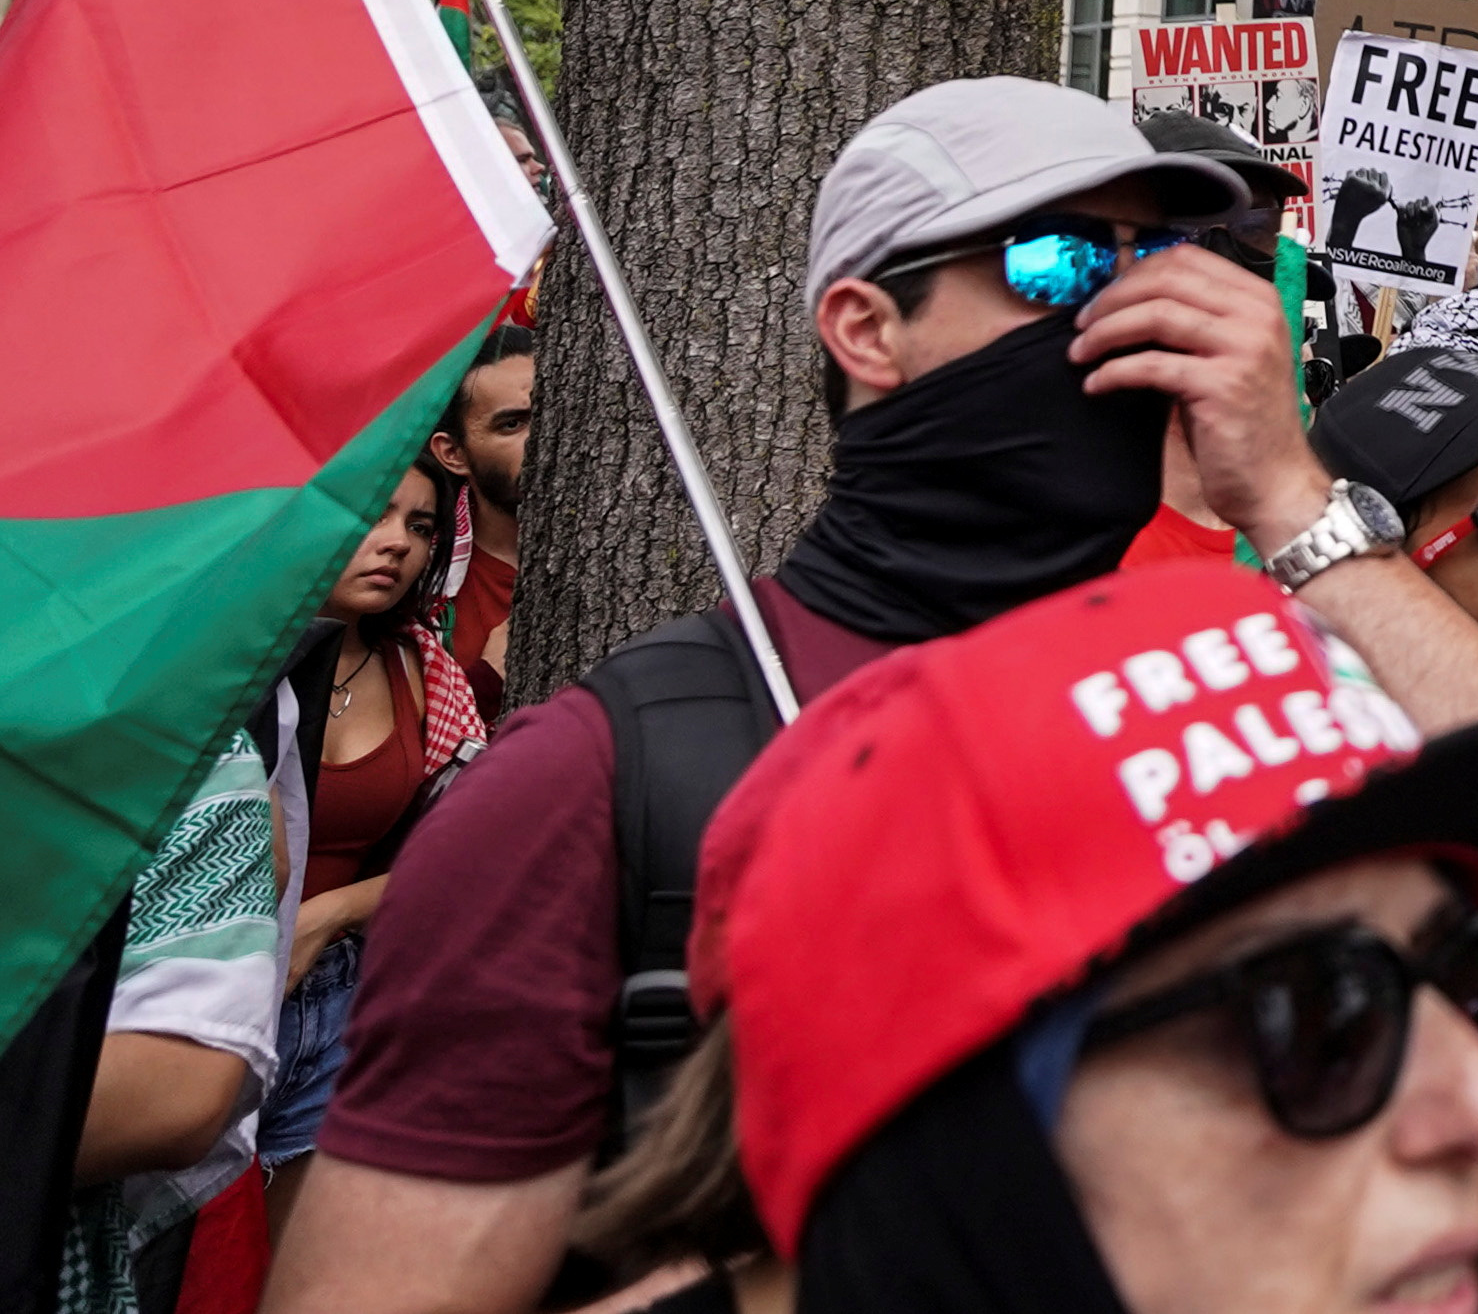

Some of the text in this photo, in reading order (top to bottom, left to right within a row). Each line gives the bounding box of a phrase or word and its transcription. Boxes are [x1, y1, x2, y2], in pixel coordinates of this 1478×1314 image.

[1139, 22, 1309, 77] WANTED
[1328, 246, 1447, 282] NSWERcoalition.org
[1070, 612, 1299, 738] FREE
